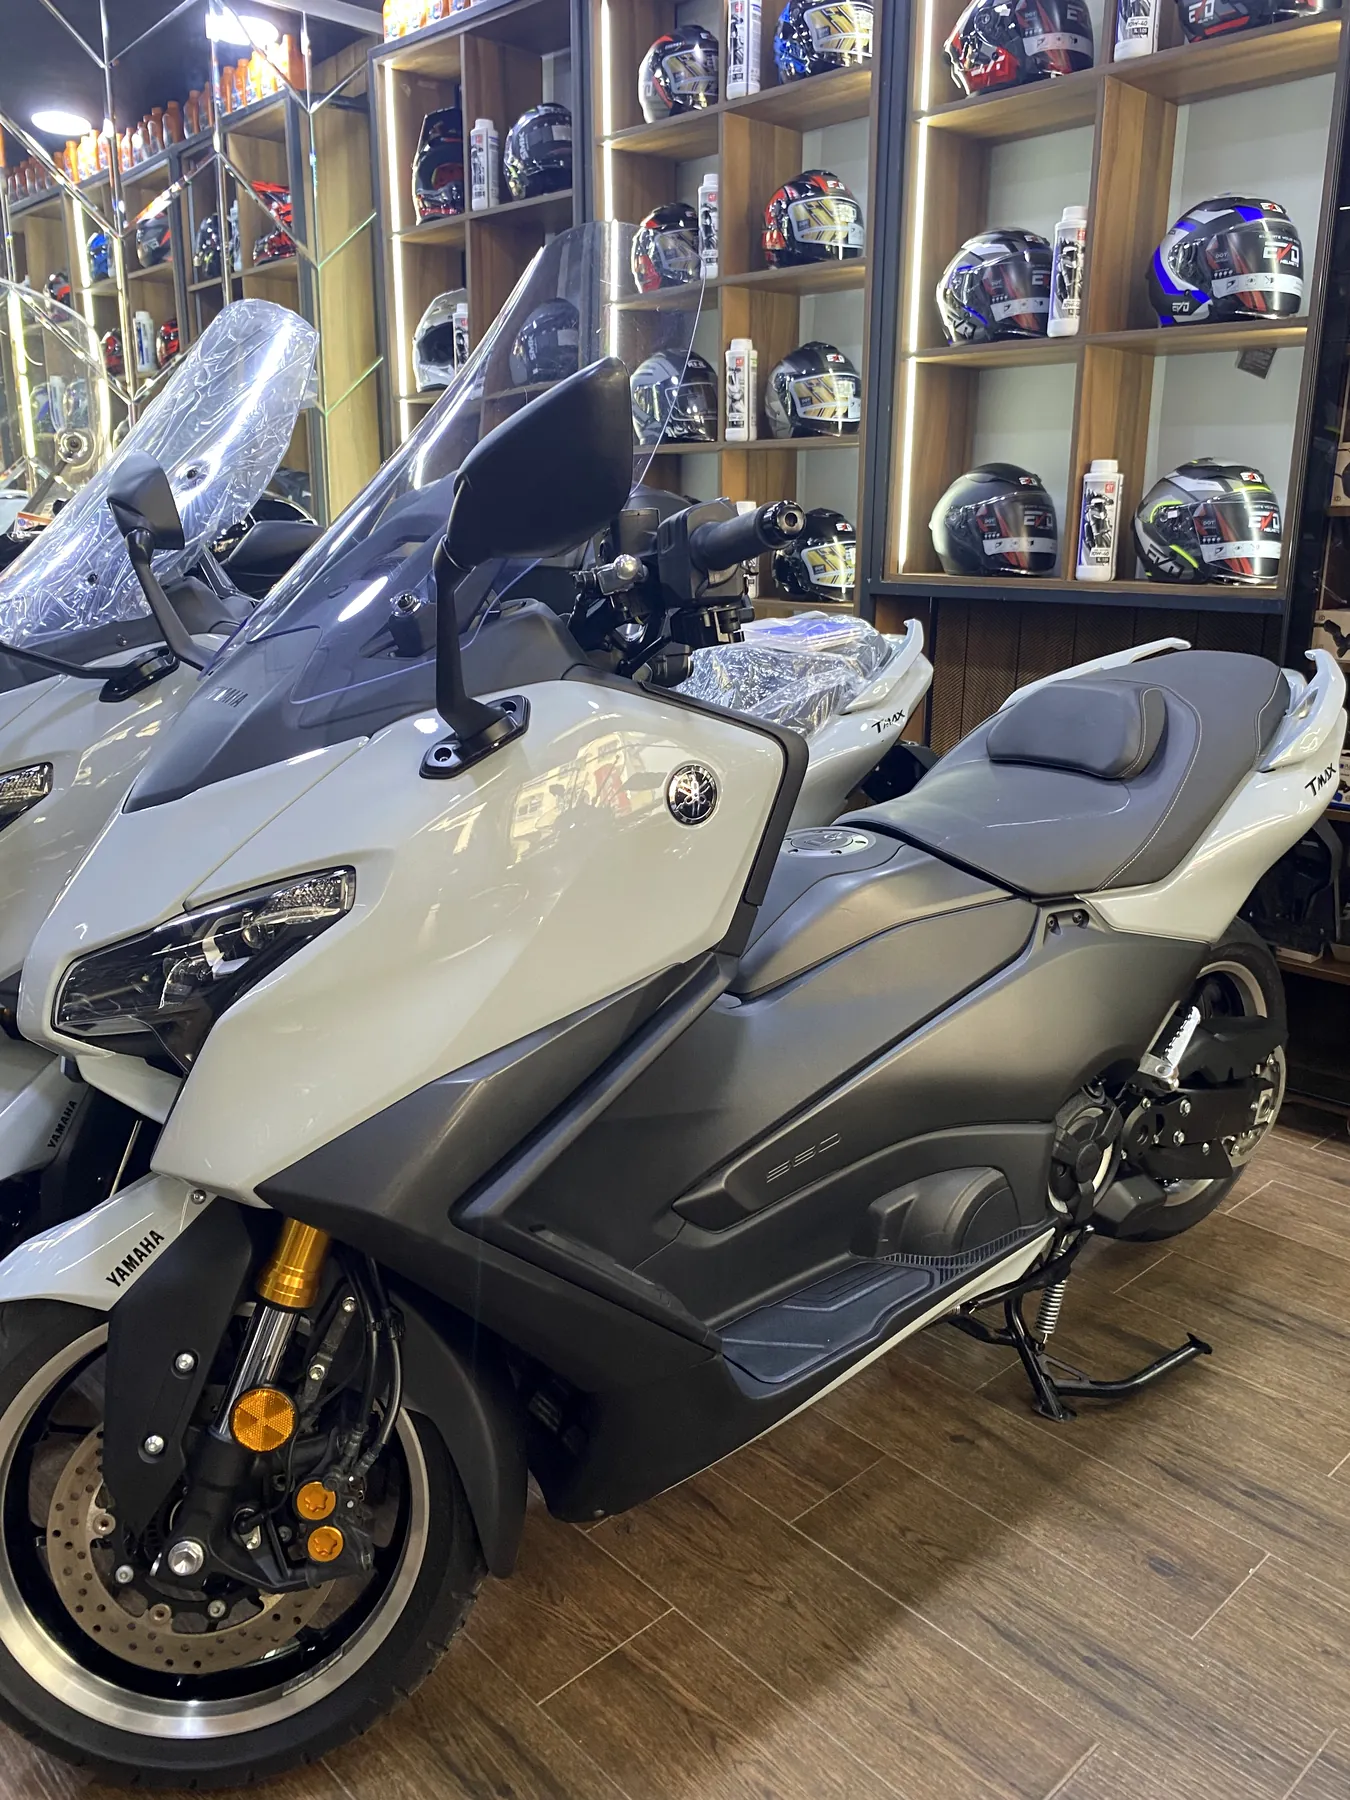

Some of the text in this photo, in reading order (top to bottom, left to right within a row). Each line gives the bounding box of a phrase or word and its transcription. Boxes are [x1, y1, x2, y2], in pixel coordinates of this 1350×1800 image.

[518, 132, 530, 160] SMK
[1263, 241, 1300, 263] EVO
[1172, 302, 1190, 313] EVO
[527, 335, 536, 361] SMK
[1024, 510, 1053, 528] EVO
[1248, 511, 1280, 530] EVO
[1147, 544, 1185, 578] EVO
[47, 1100, 78, 1149] YAMAHA
[105, 1230, 165, 1287] YAMAHA
